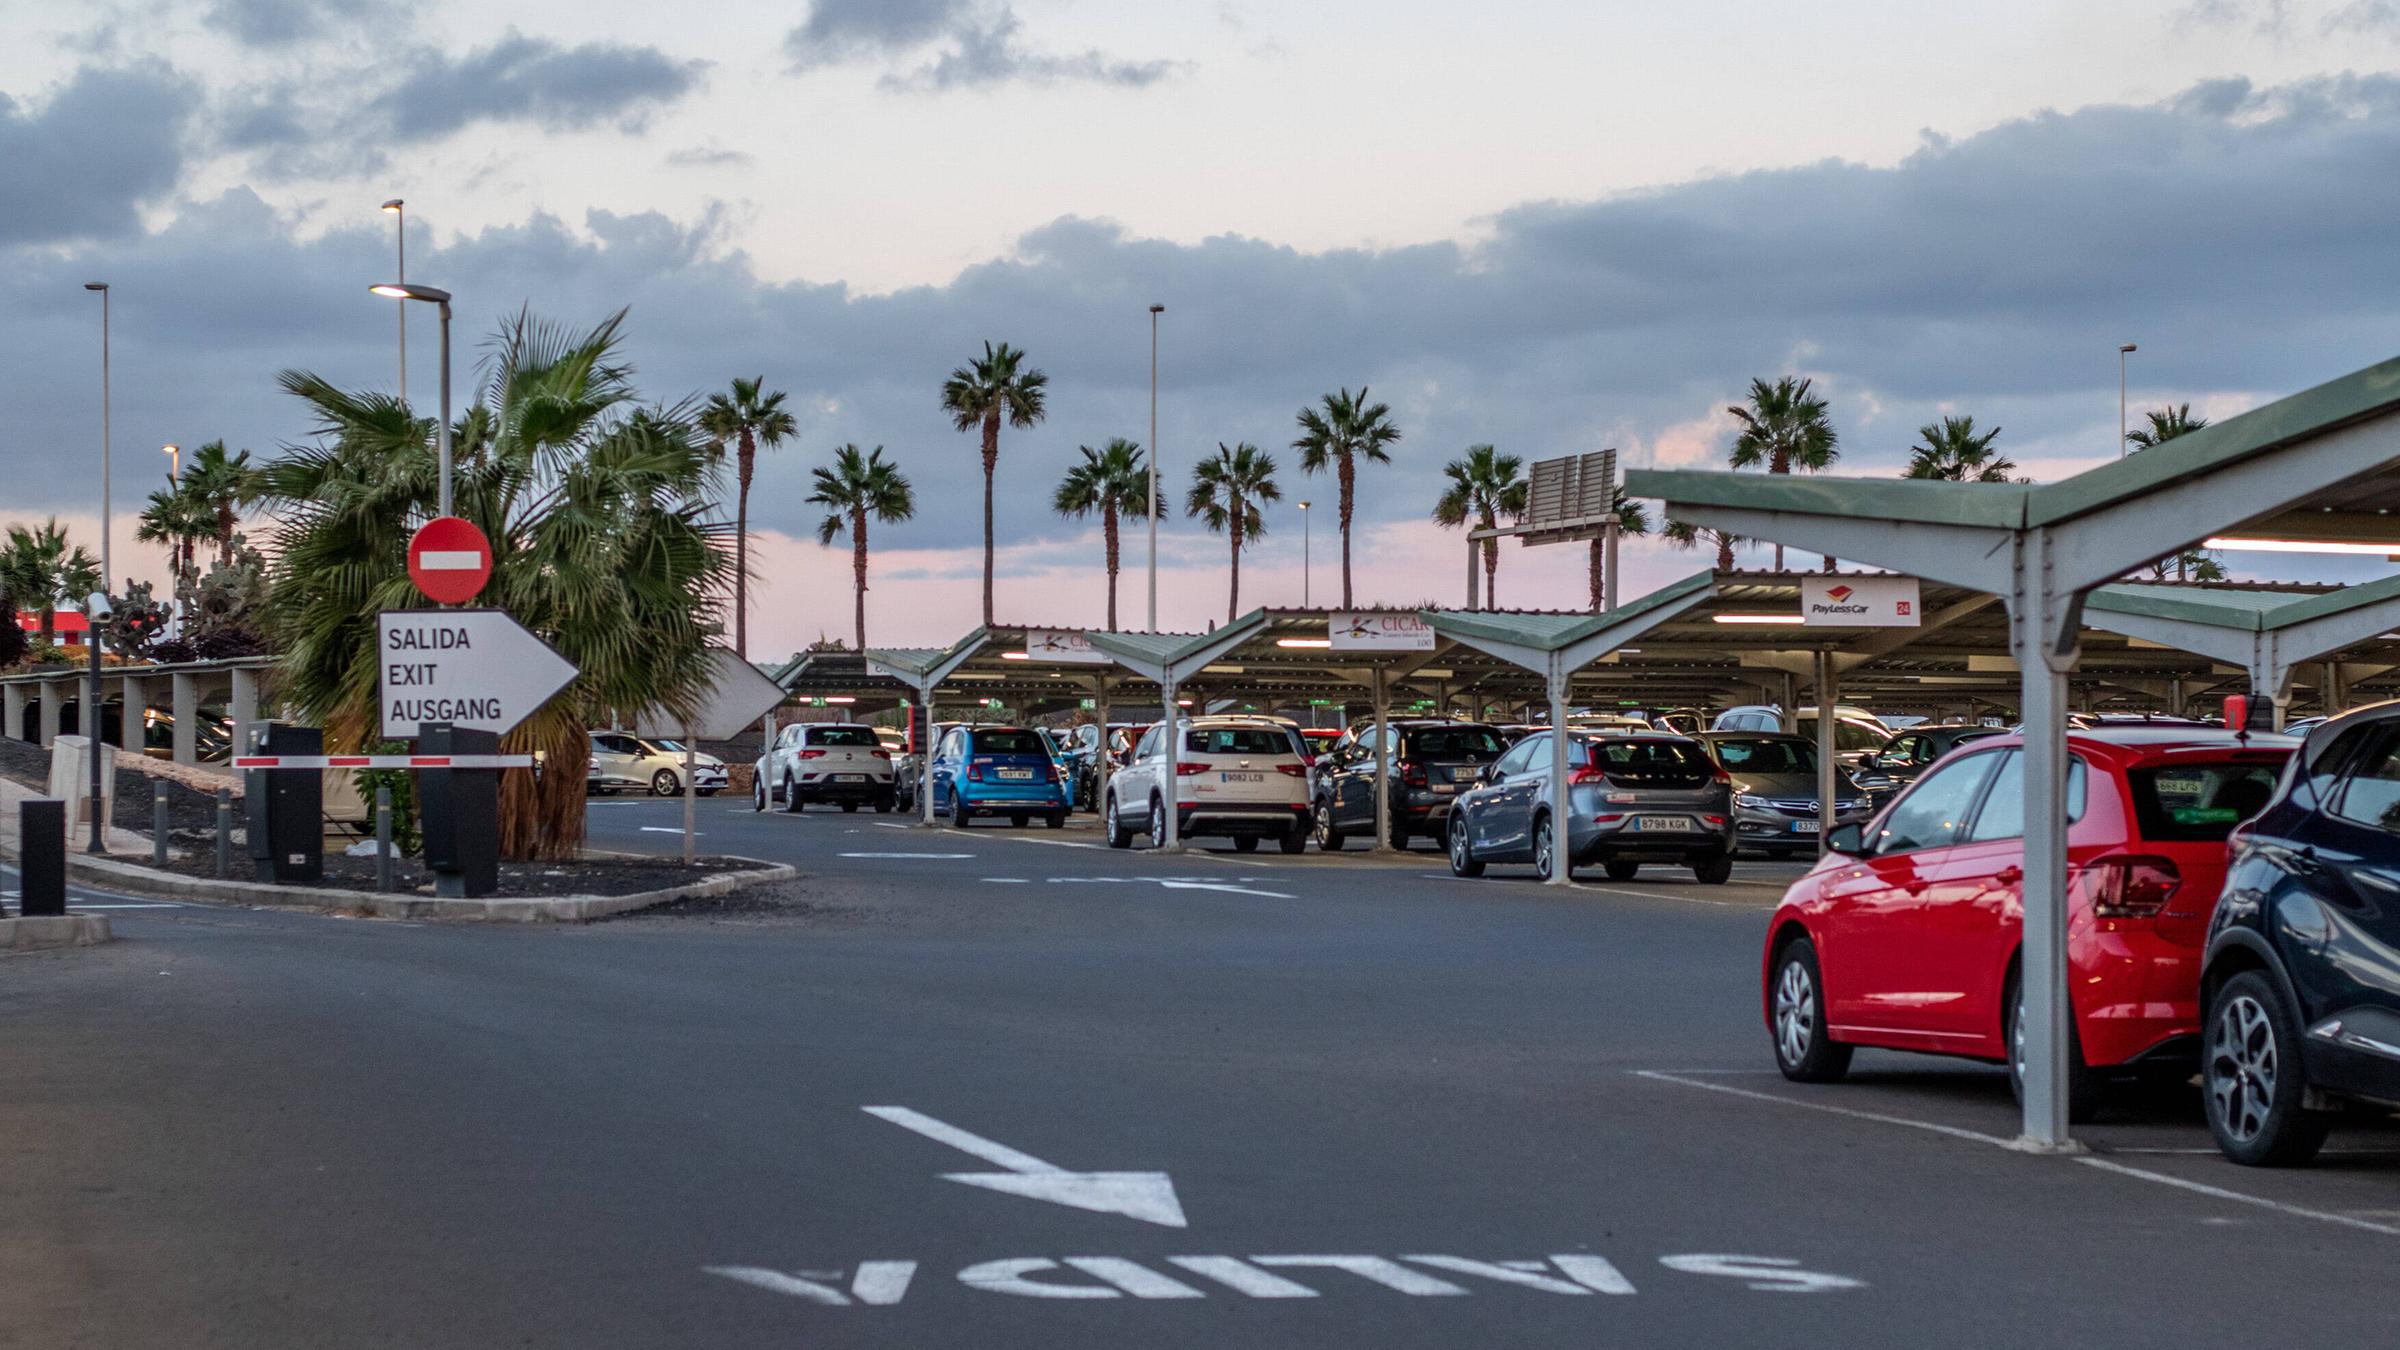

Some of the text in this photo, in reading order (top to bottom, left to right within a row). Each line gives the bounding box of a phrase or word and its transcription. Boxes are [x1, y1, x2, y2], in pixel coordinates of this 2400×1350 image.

[1898, 603, 1909, 614] 24
[388, 628, 471, 650] SALIDA
[1417, 639, 1432, 647] 100
[389, 664, 437, 685] EXIT
[1081, 699, 1096, 709] 48
[390, 699, 501, 721] AUSGANG
[1642, 819, 1688, 829] 8798 KGK
[1798, 822, 1819, 831] 8370
